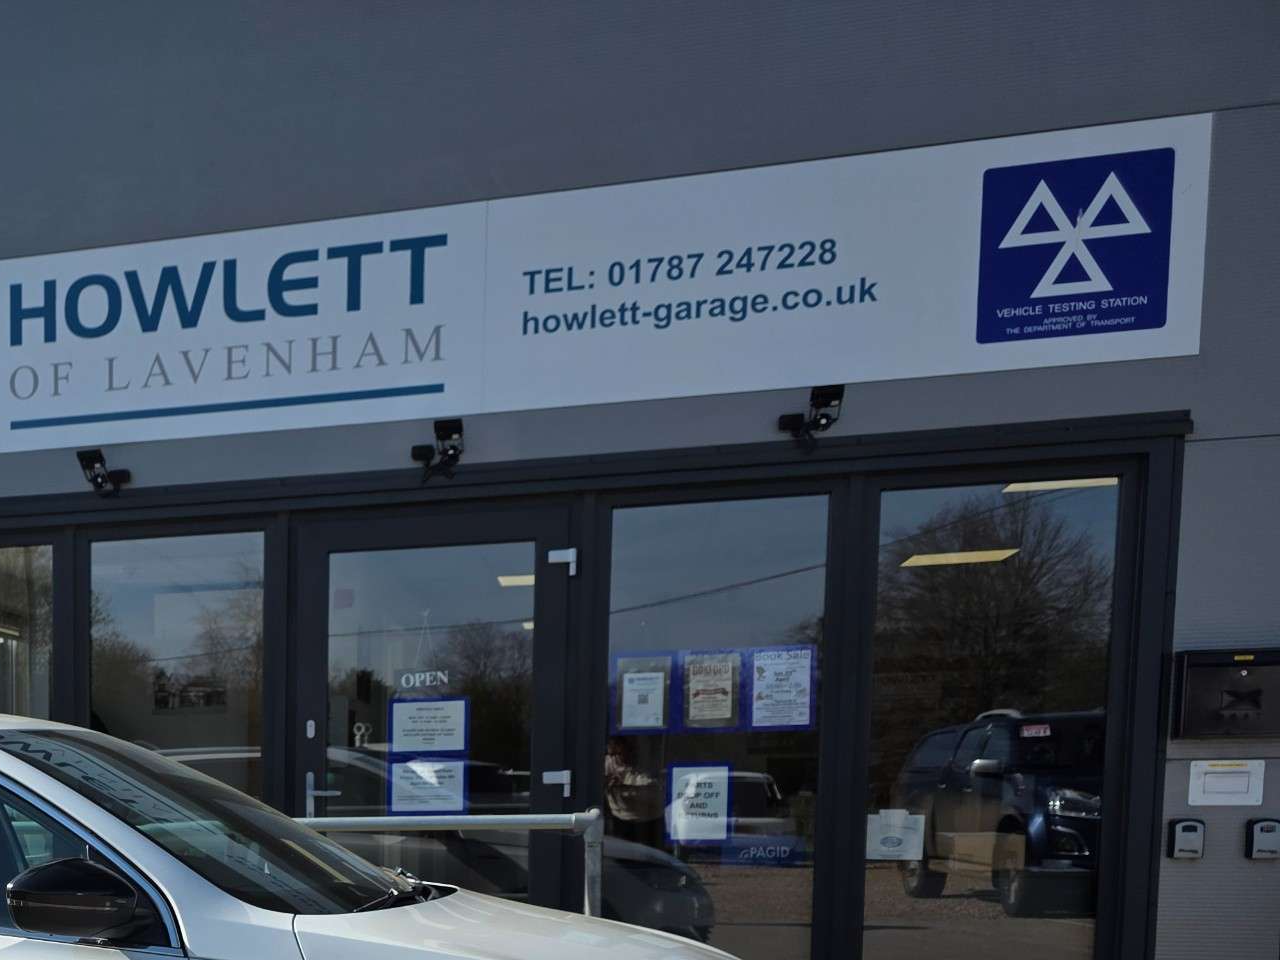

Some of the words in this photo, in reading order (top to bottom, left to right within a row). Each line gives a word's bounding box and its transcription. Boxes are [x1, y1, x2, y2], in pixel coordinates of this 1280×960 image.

[522, 267, 595, 295] TEL:
[608, 253, 705, 287] 01787
[715, 238, 838, 277] 247228
[9, 233, 448, 347] HOWLETT
[521, 277, 879, 336] howlett-garage.co.uk
[996, 305, 1043, 319] VEHICLE
[1048, 300, 1096, 314] TESTING
[1100, 295, 1148, 309] STATION
[1006, 327, 1021, 335] THE
[1023, 322, 1073, 333] DEPARTMENT
[1075, 320, 1087, 329] OF
[1090, 316, 1136, 327] TRANSPORT
[1043, 315, 1084, 325] APPROVED
[9, 361, 73, 401] OF
[104, 324, 447, 393] LAVENHAM
[400, 670, 449, 688] OPEN
[750, 845, 790, 858] PAGID
